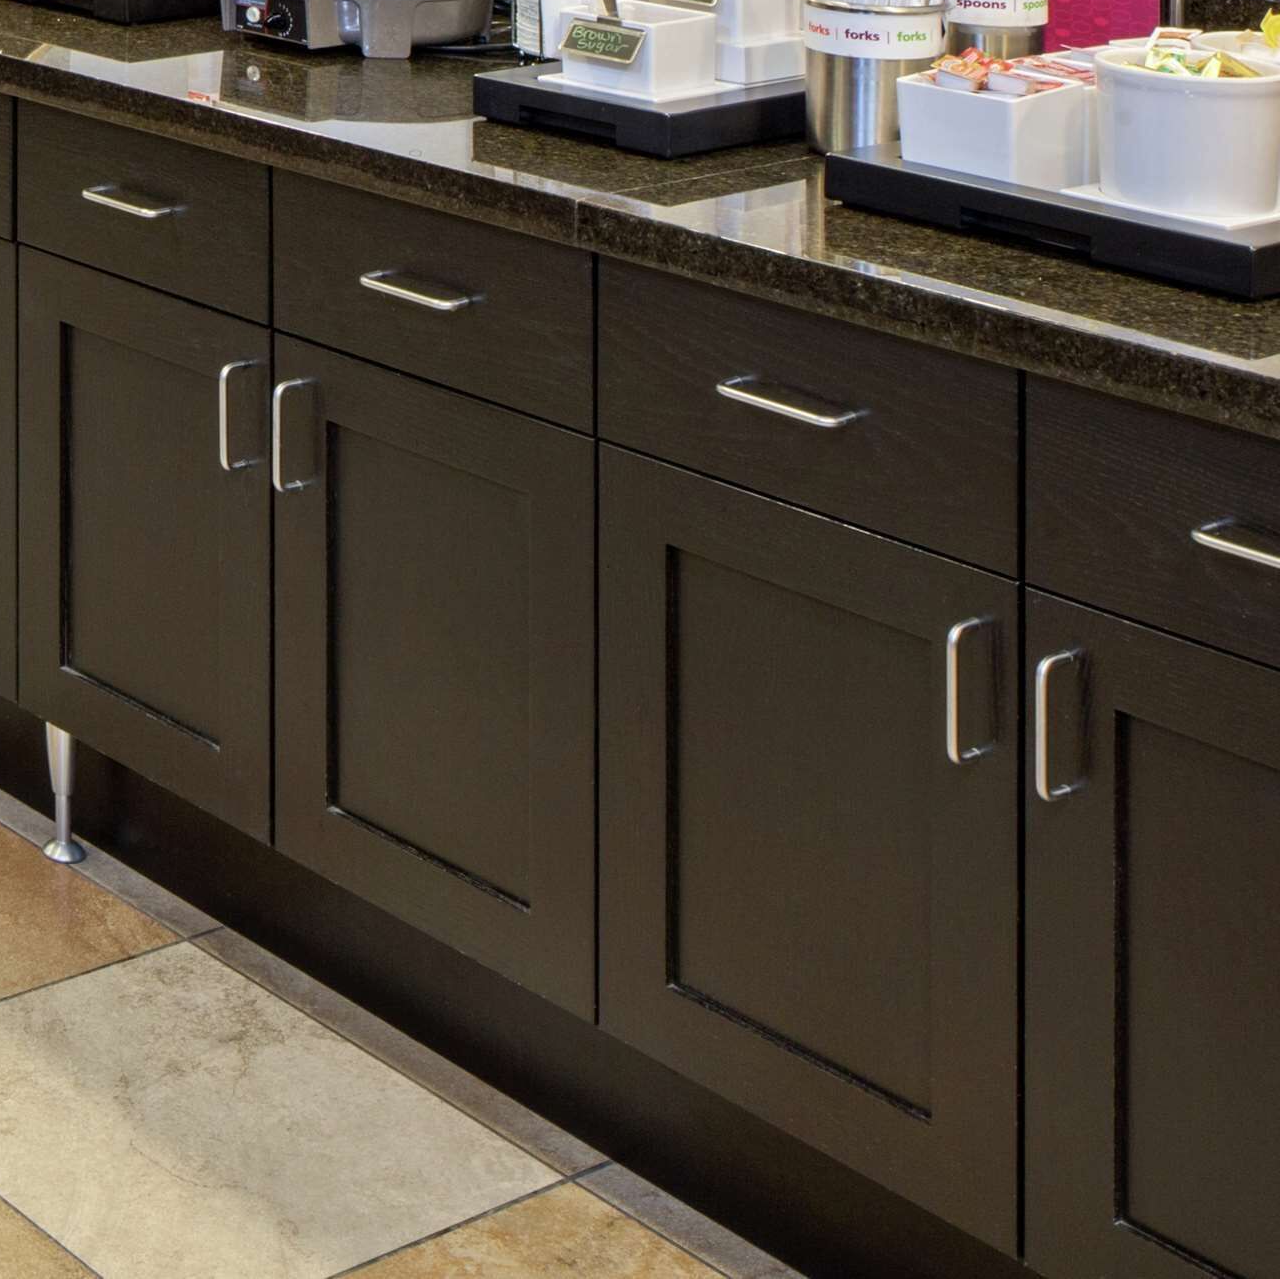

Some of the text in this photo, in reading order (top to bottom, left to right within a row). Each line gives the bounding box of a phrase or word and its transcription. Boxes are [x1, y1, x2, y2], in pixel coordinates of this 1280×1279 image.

[572, 26, 622, 43] Brown
[844, 28, 881, 41] forks
[897, 31, 927, 42] forks
[576, 39, 629, 54] Sugar
